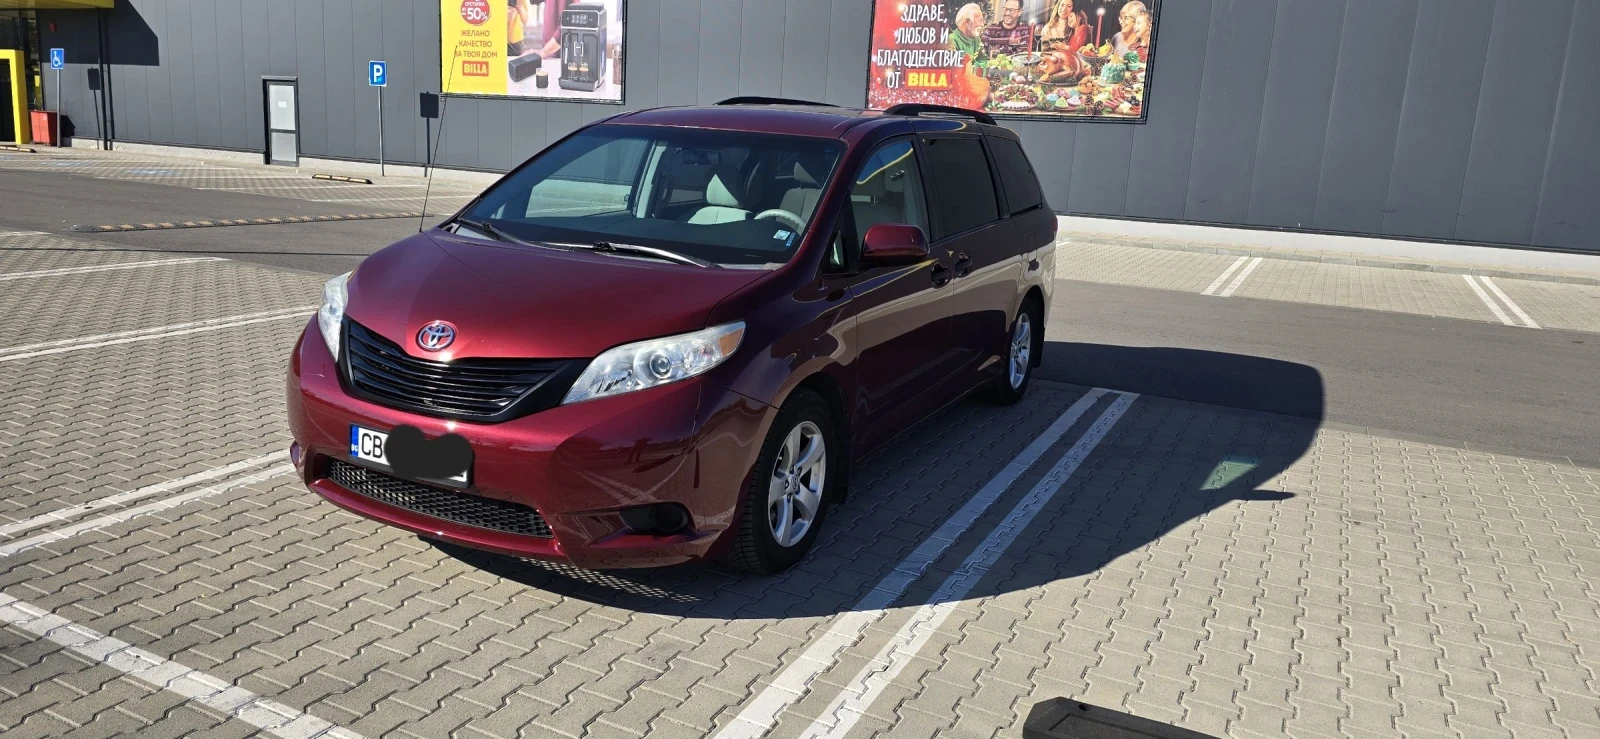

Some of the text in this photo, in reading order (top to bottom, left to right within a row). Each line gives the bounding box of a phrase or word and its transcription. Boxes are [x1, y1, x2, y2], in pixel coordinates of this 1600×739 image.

[900, 4, 948, 23] ЗДРАВЕ,
[460, 29, 491, 37] ЖЕЛАНО
[895, 27, 949, 44] ЛЮБОВ И
[458, 40, 493, 48] КАЧЕСТВО
[463, 50, 481, 58] ТВОЯ
[481, 51, 498, 59] ДОМ
[876, 49, 965, 69] БЛАГОДЕНСТВИЕ
[373, 64, 383, 83] P
[463, 63, 488, 74] BILLA
[886, 71, 948, 89] ОТ BILLA
